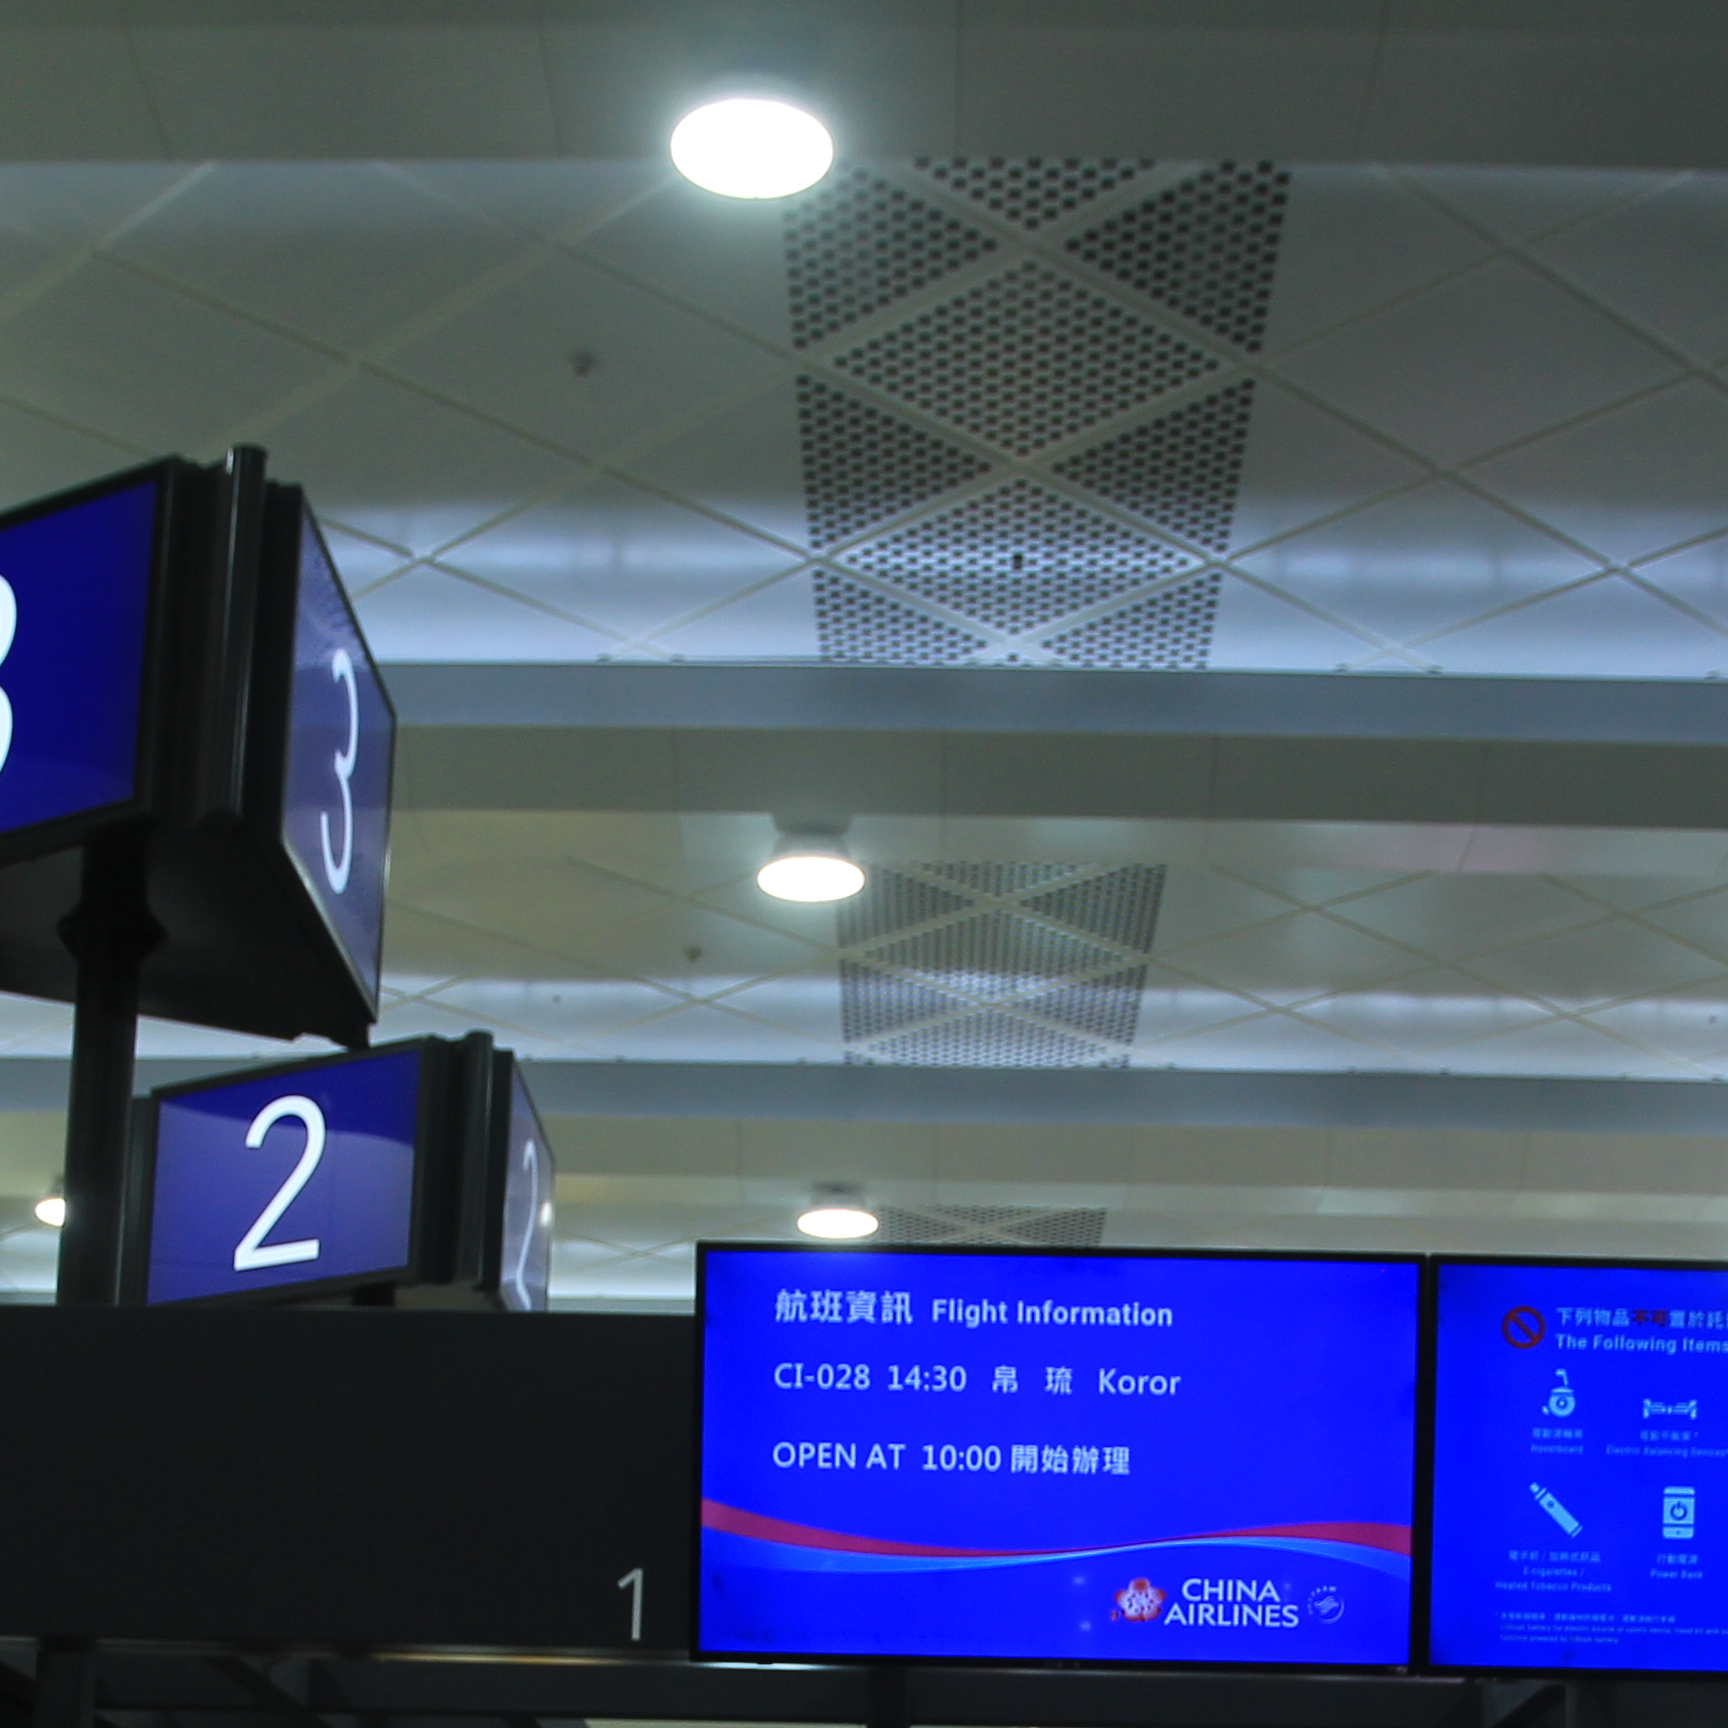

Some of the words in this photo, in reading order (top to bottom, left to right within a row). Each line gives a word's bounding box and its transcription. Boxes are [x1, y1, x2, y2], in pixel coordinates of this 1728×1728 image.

[320, 648, 359, 894] 3
[233, 1095, 328, 1272] 2
[774, 1289, 914, 1325] 航班資訊
[932, 1296, 1010, 1328] Flight
[1016, 1298, 1173, 1328] Information
[1555, 1333, 1588, 1352] The
[1593, 1334, 1676, 1356] Following
[774, 1363, 871, 1391] CI-028
[888, 1365, 967, 1392] 14:30
[1098, 1368, 1181, 1395] Koror
[772, 1442, 857, 1470] OPEN
[866, 1442, 906, 1470] AT
[922, 1444, 1002, 1472] 10:00
[1011, 1444, 1130, 1475] 開始辦理
[617, 1567, 644, 1641] 1
[1181, 1577, 1280, 1603] CHINA
[1163, 1602, 1299, 1628] AIRLINES
